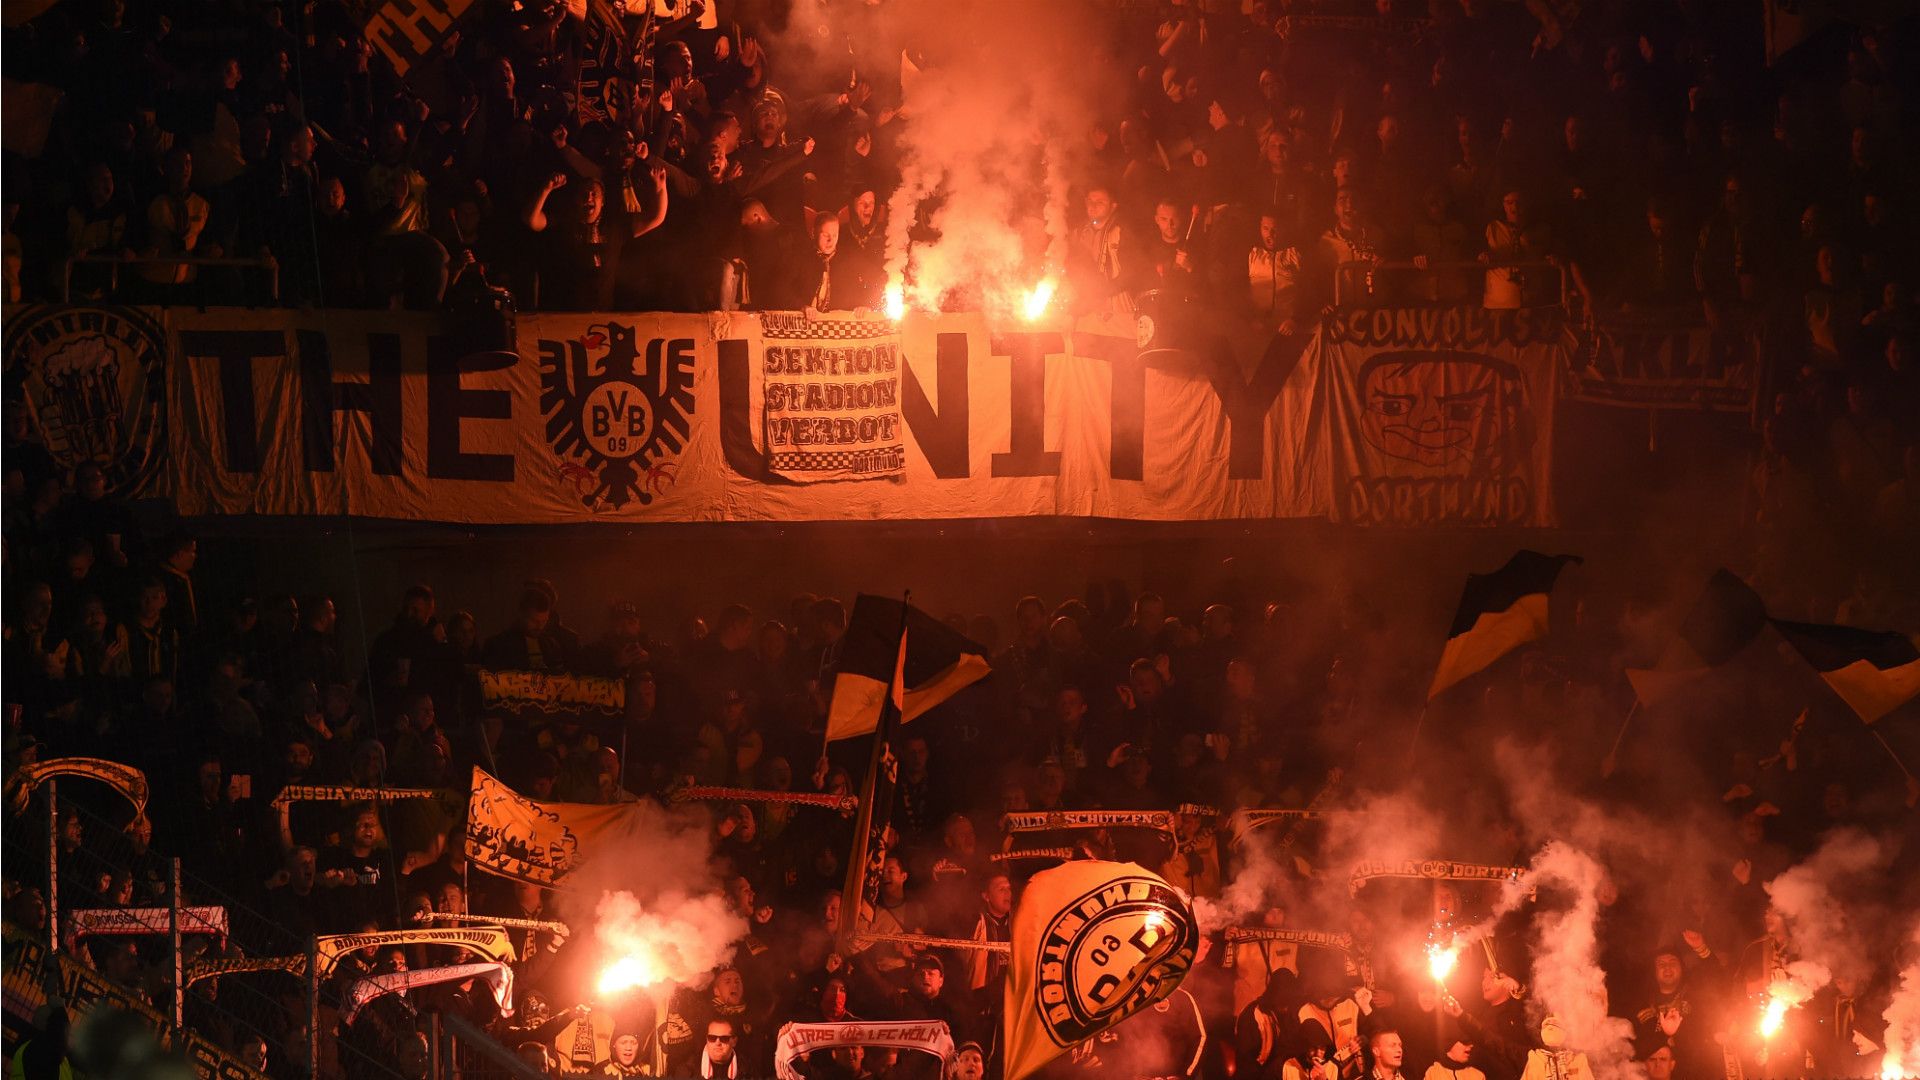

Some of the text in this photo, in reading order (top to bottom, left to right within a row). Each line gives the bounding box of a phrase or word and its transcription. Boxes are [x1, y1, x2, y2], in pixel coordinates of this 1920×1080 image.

[766, 345, 898, 375] SEKTION
[177, 329, 516, 482] THE
[767, 379, 898, 411] STADION
[592, 390, 646, 437] BVB
[608, 437, 628, 452] 09
[335, 931, 496, 950] BORUSSIA DORTMUND
[786, 1028, 835, 1049] ULTRAS
[899, 1026, 942, 1044] KÖLN
